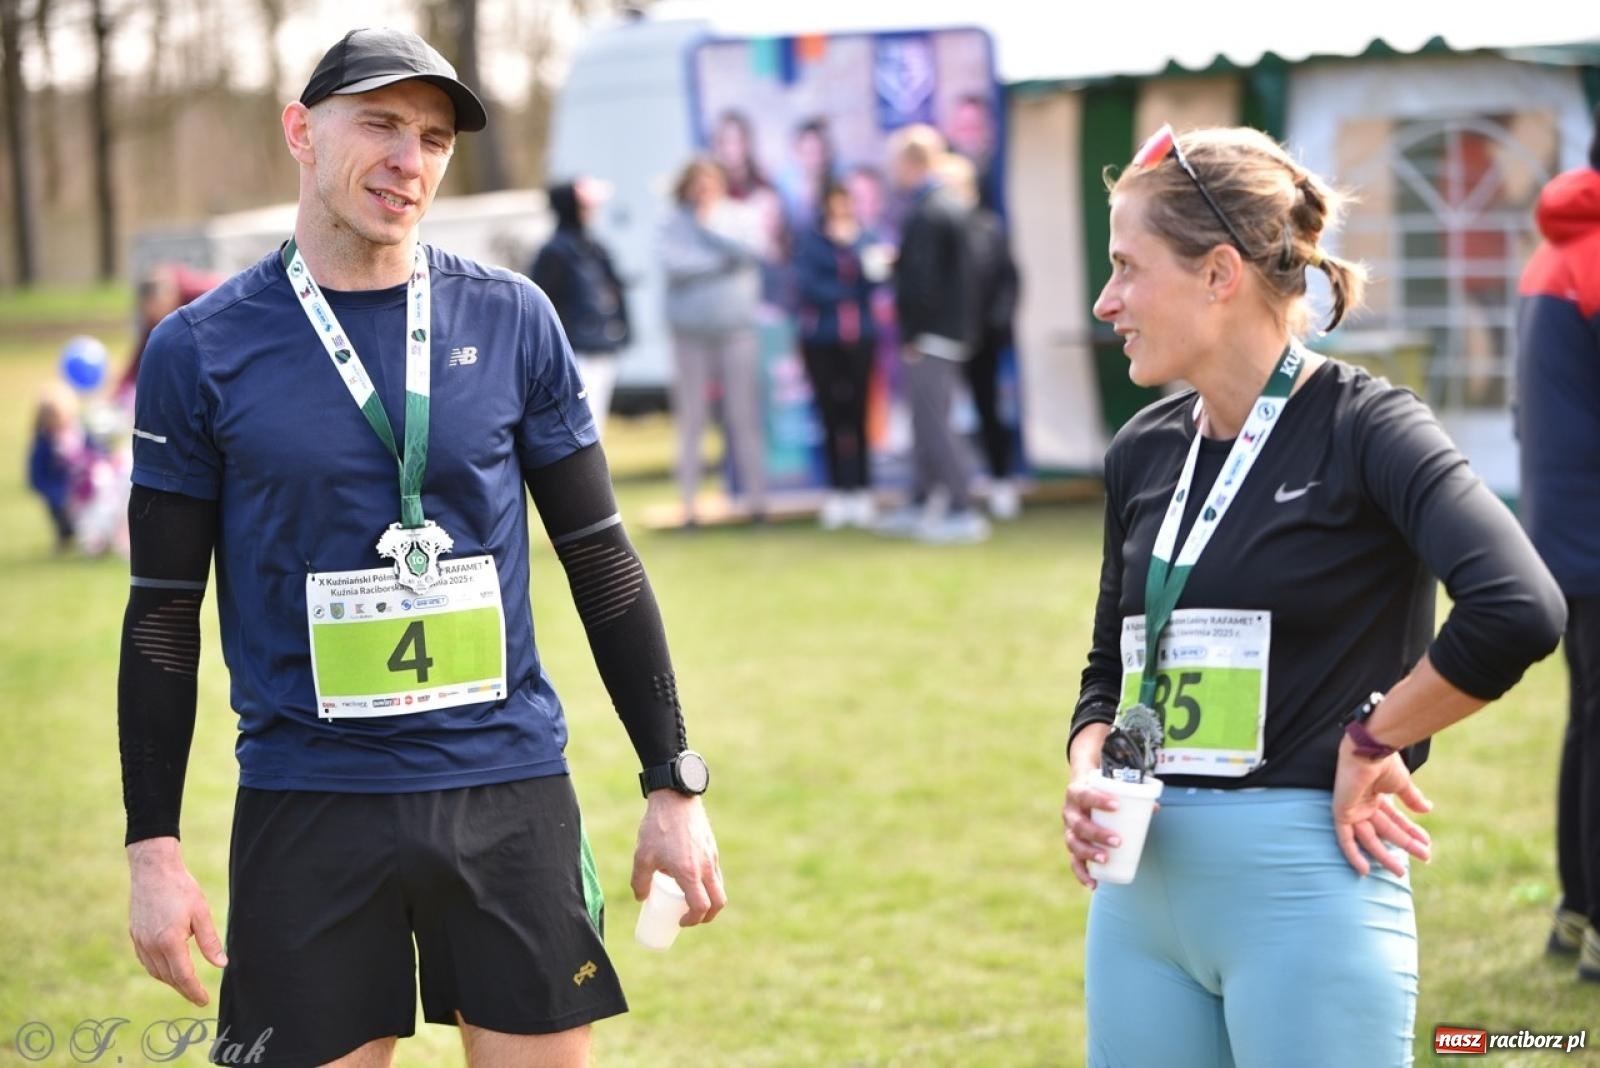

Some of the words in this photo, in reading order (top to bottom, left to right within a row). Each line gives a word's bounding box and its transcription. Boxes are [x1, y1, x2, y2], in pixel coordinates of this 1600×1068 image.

[445, 563, 483, 574] RAFAMET
[331, 587, 358, 596] Kuźnia
[449, 576, 468, 585] 2025
[387, 620, 433, 683] 4
